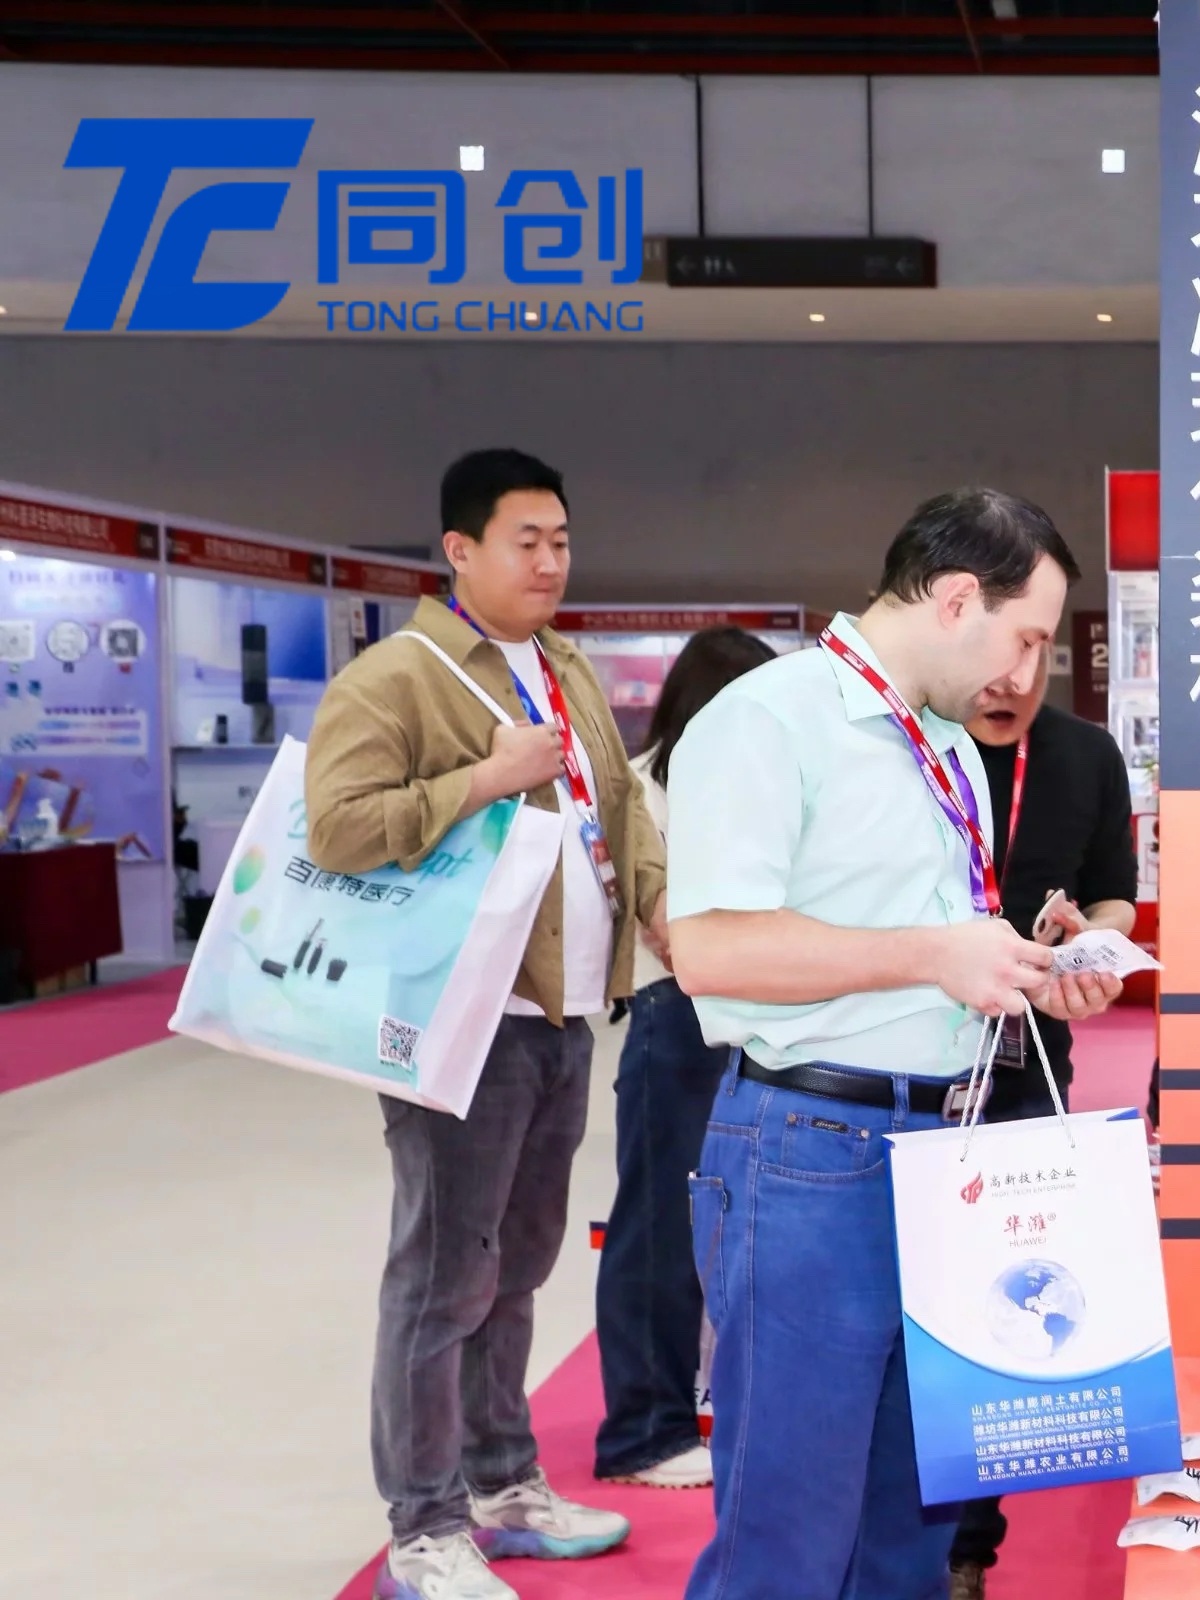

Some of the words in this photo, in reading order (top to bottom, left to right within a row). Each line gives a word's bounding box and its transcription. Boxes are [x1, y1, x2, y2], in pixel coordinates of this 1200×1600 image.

[990, 1166, 1077, 1188] 高新技术企业
[1009, 1236, 1047, 1248] HUAWEI
[977, 1445, 1129, 1475] 山东华潍农业有限公司
